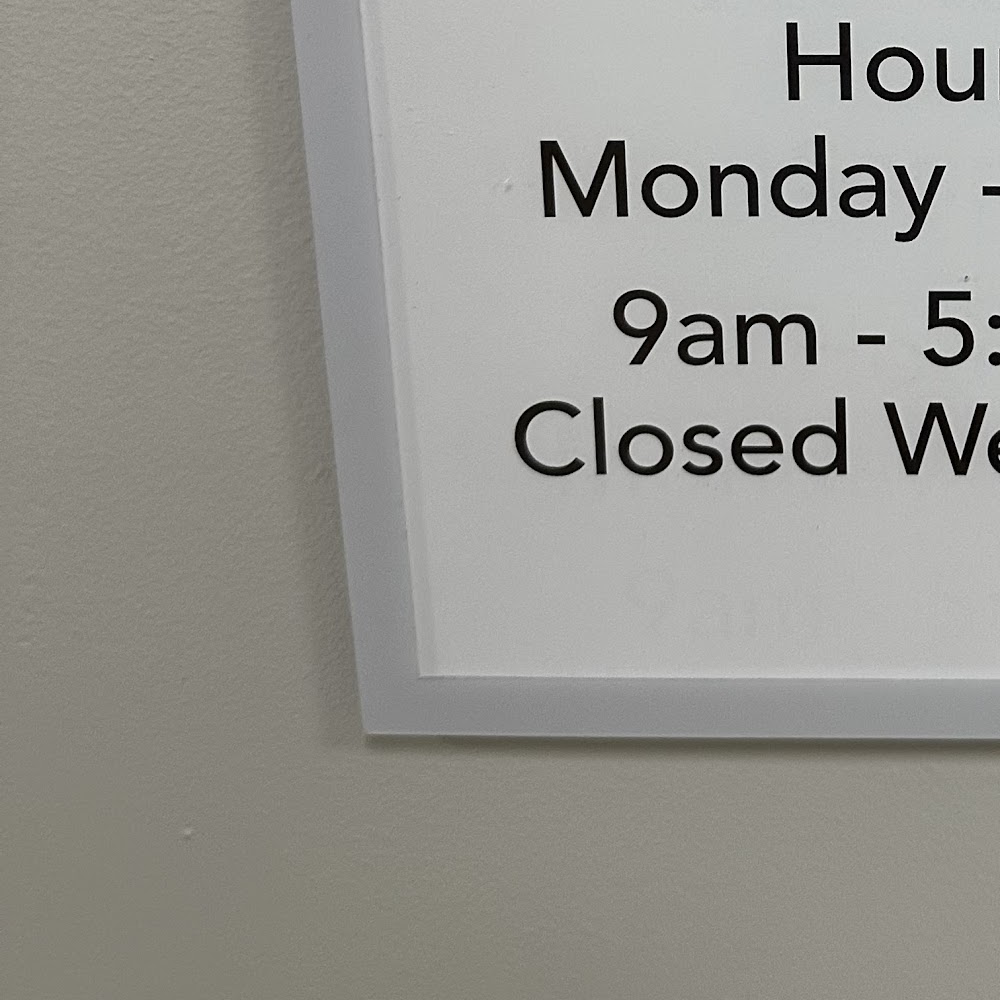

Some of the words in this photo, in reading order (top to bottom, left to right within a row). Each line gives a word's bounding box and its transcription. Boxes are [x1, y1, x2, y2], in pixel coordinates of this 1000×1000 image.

[539, 134, 947, 243] Monday
[612, 289, 818, 368] 9am
[513, 396, 848, 477] Closed
